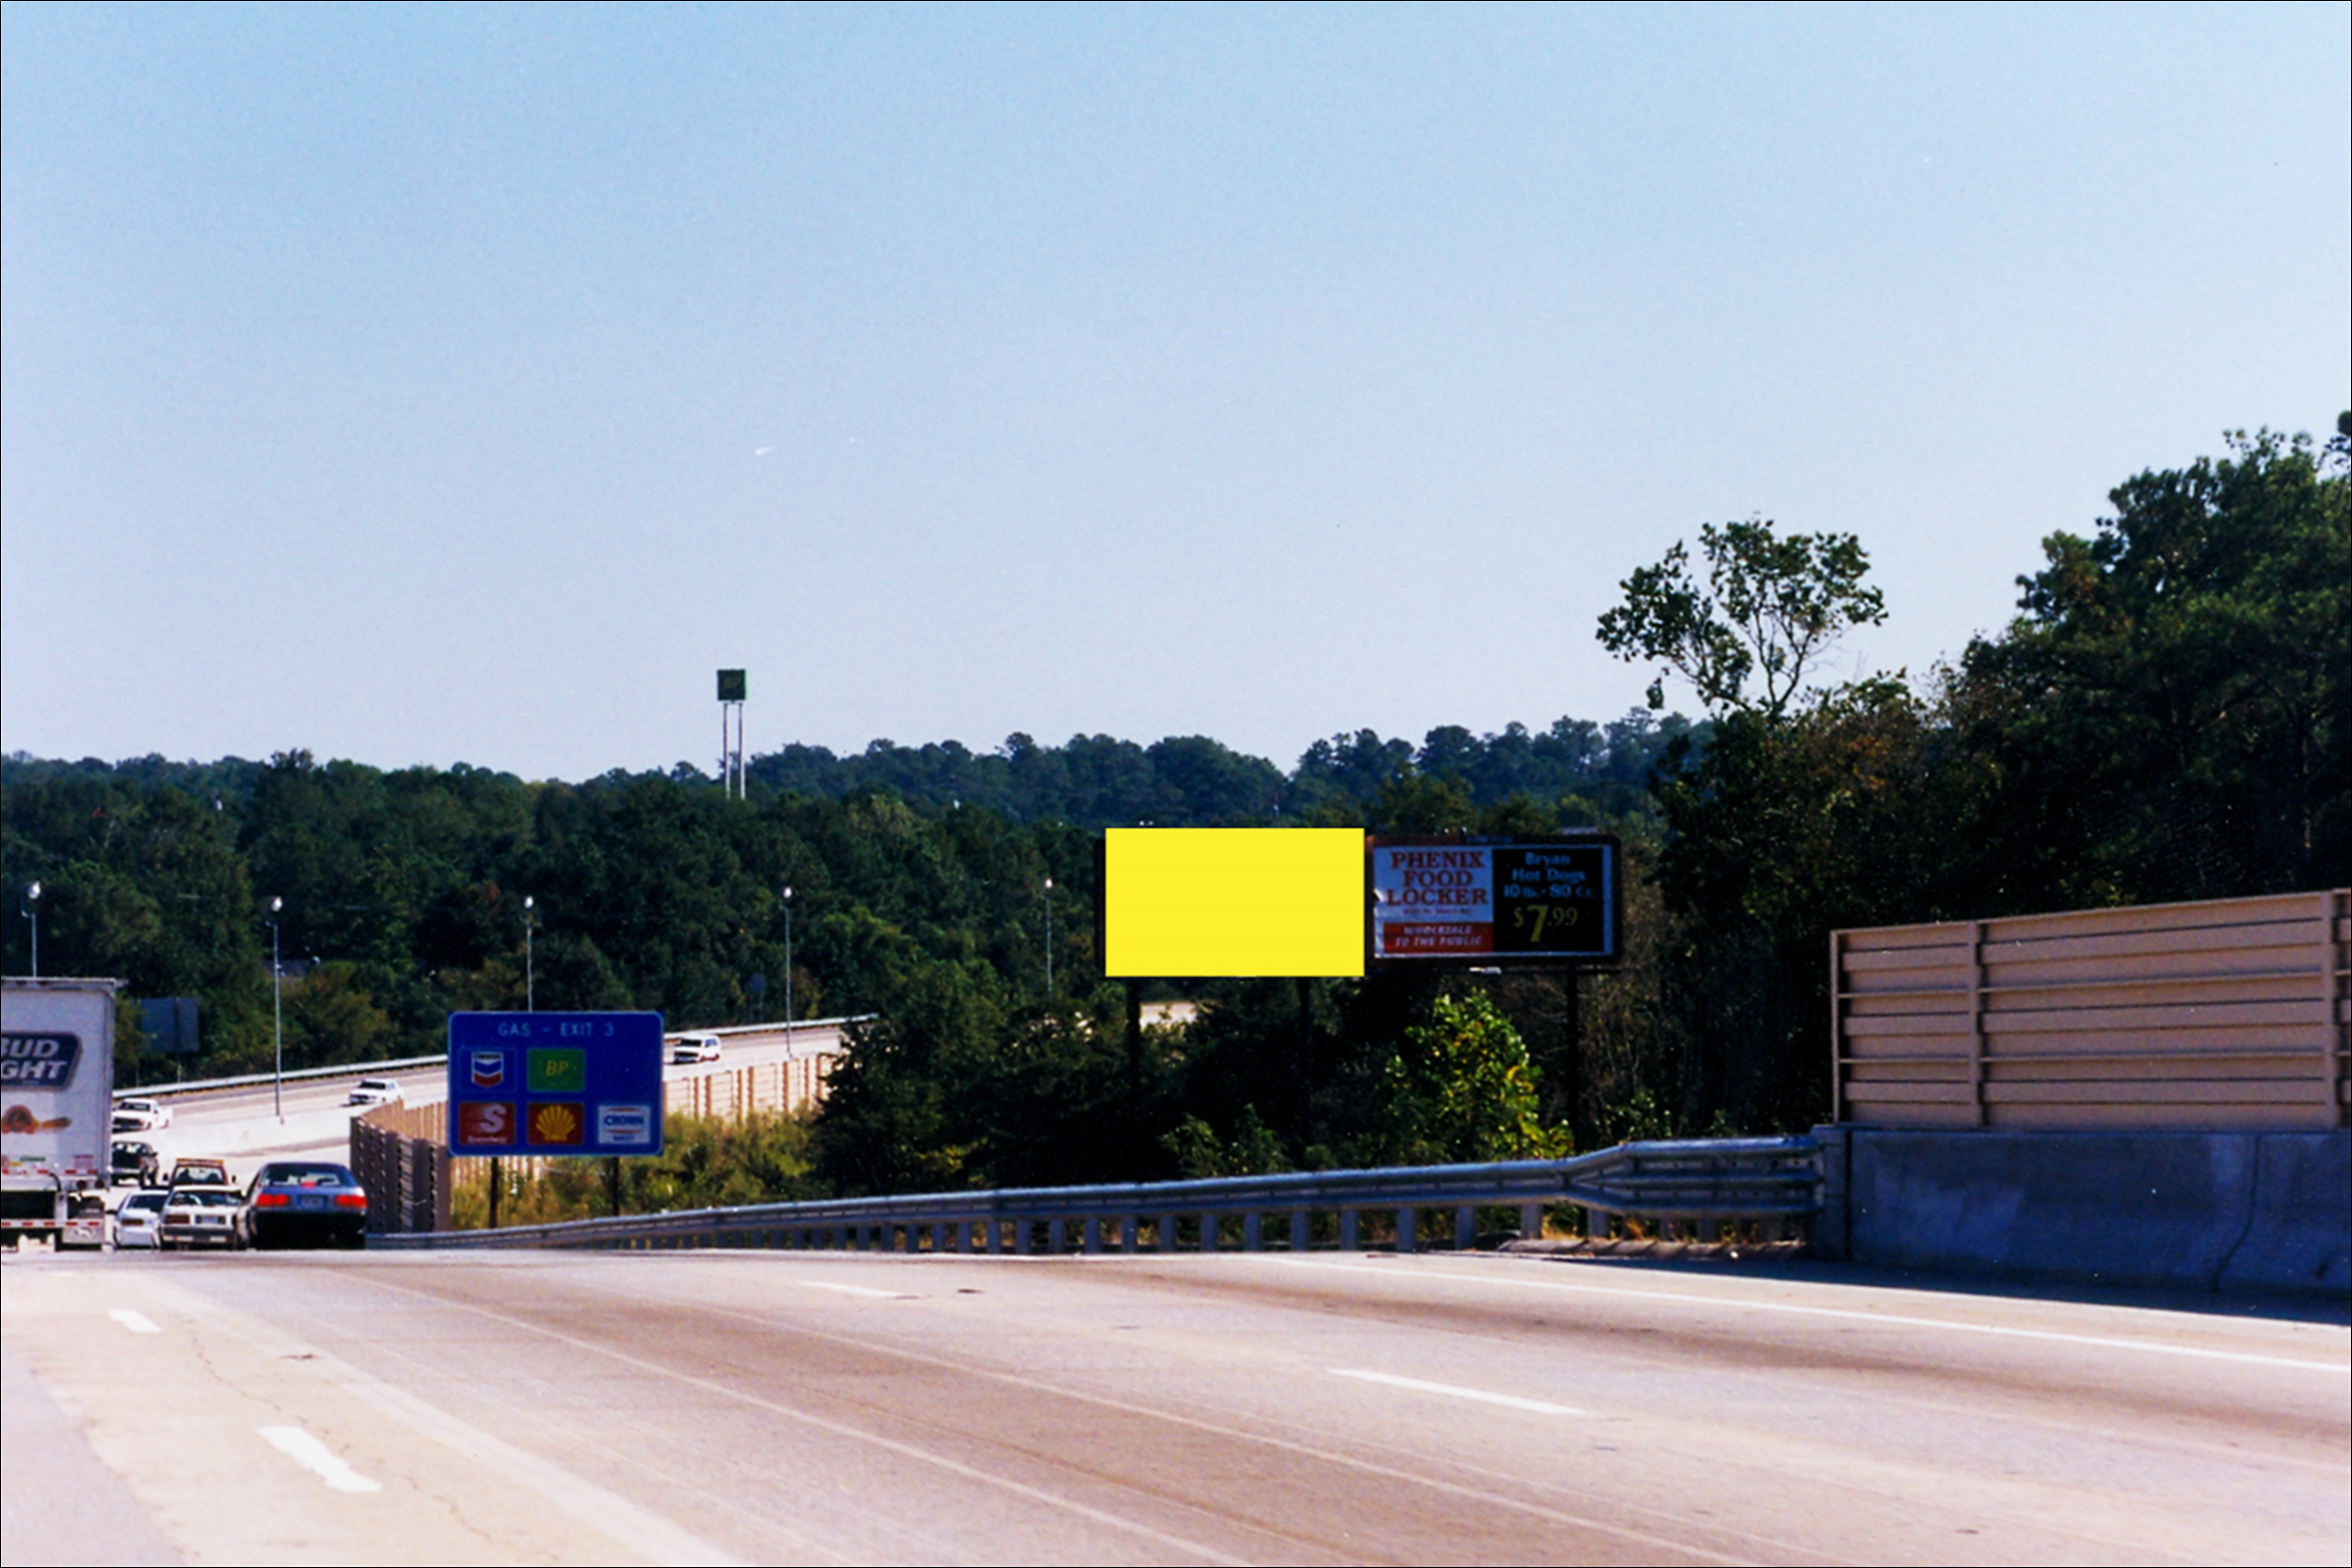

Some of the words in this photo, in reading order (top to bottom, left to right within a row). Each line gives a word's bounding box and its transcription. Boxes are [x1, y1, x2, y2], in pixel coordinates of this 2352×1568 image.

[1392, 851, 1485, 869] PHENIX
[1526, 852, 1571, 868] Bryan
[1402, 869, 1473, 888] FOOD
[1512, 867, 1542, 882] Hot
[1546, 867, 1587, 886] Dogs
[1387, 888, 1488, 906] LOCKER
[1503, 883, 1521, 899] 10
[1549, 883, 1572, 899] 80
[1403, 925, 1472, 935] WHOLESALE
[1396, 937, 1409, 947] TO
[1413, 937, 1436, 947] THE
[1440, 935, 1482, 947] PUBLIC
[498, 1022, 531, 1037] GAS
[560, 1022, 593, 1037] EXIT
[605, 1022, 614, 1037] 3
[545, 1059, 569, 1076] BP
